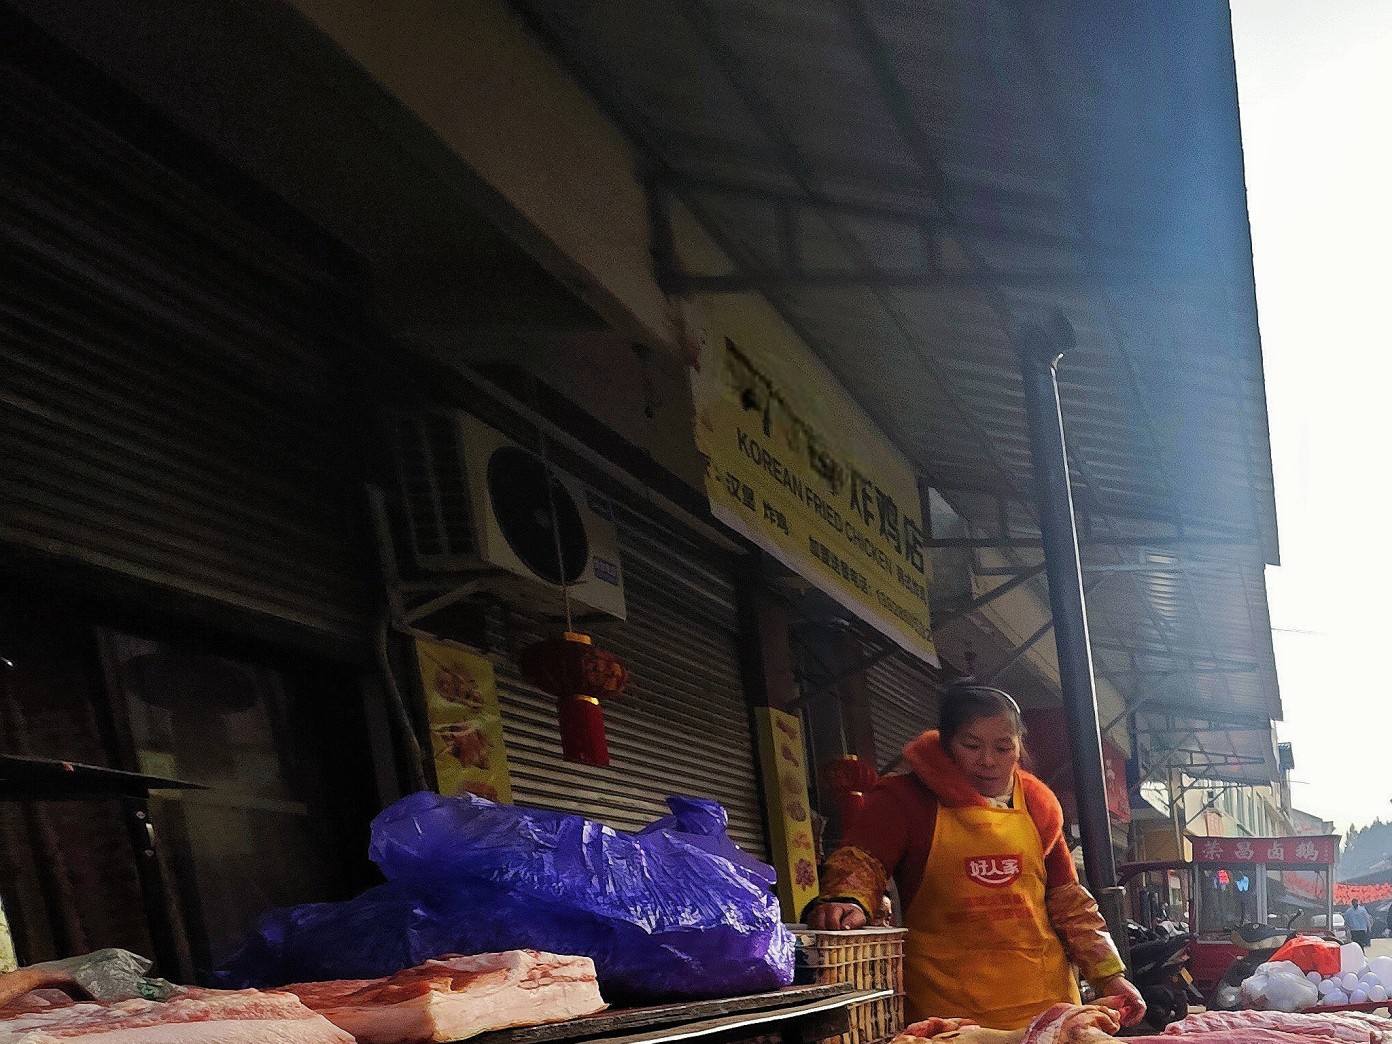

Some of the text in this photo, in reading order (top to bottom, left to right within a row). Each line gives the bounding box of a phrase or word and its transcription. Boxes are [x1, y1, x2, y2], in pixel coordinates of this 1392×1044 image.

[737, 426, 804, 502] KOREAN
[805, 485, 843, 533] FRIED
[845, 520, 893, 576] CHICKEN
[1201, 839, 1319, 862] 荣昌卤鹅
[970, 858, 1020, 877] 好人家
